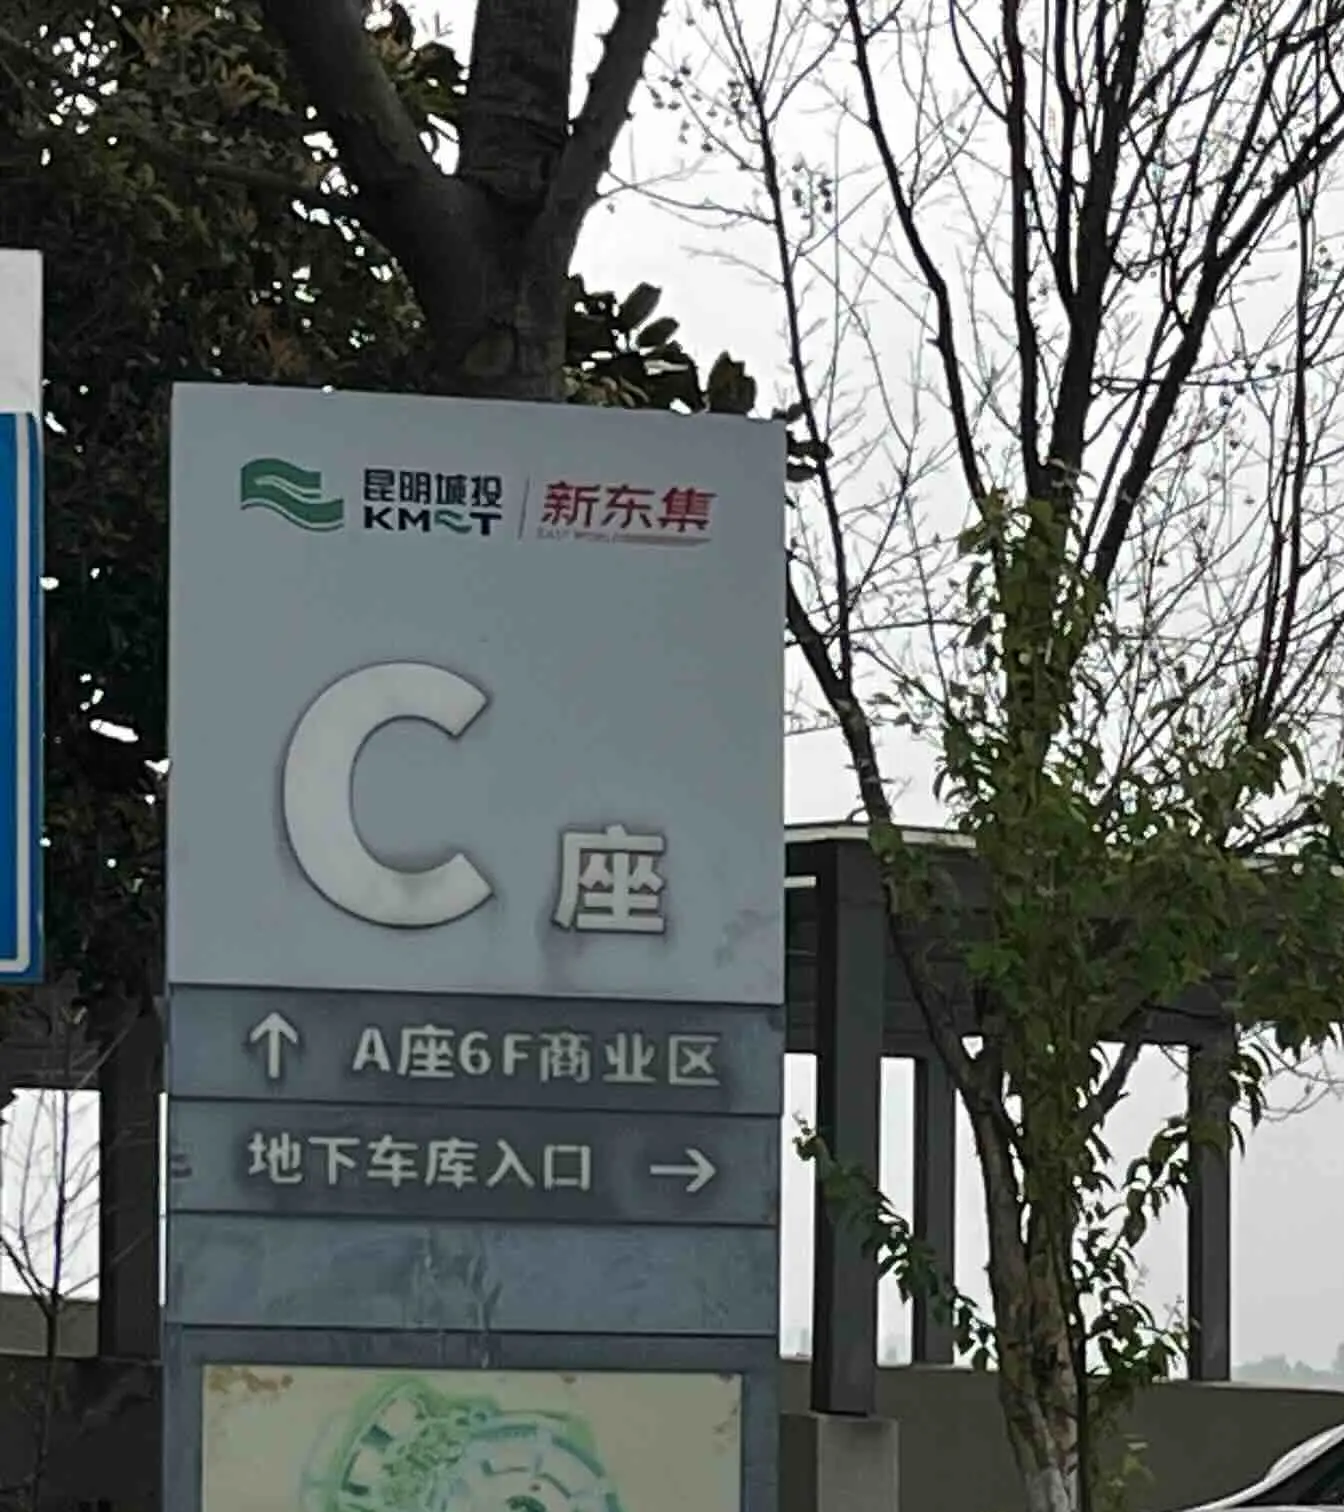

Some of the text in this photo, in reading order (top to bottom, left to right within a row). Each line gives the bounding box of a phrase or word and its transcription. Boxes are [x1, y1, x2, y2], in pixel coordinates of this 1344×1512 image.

[363, 468, 502, 508] 昆明城投
[541, 480, 717, 532] 新东集
[282, 660, 666, 934] C 座
[352, 1024, 722, 1087] A座6F商业区
[247, 1132, 592, 1190] 地下车库入口
